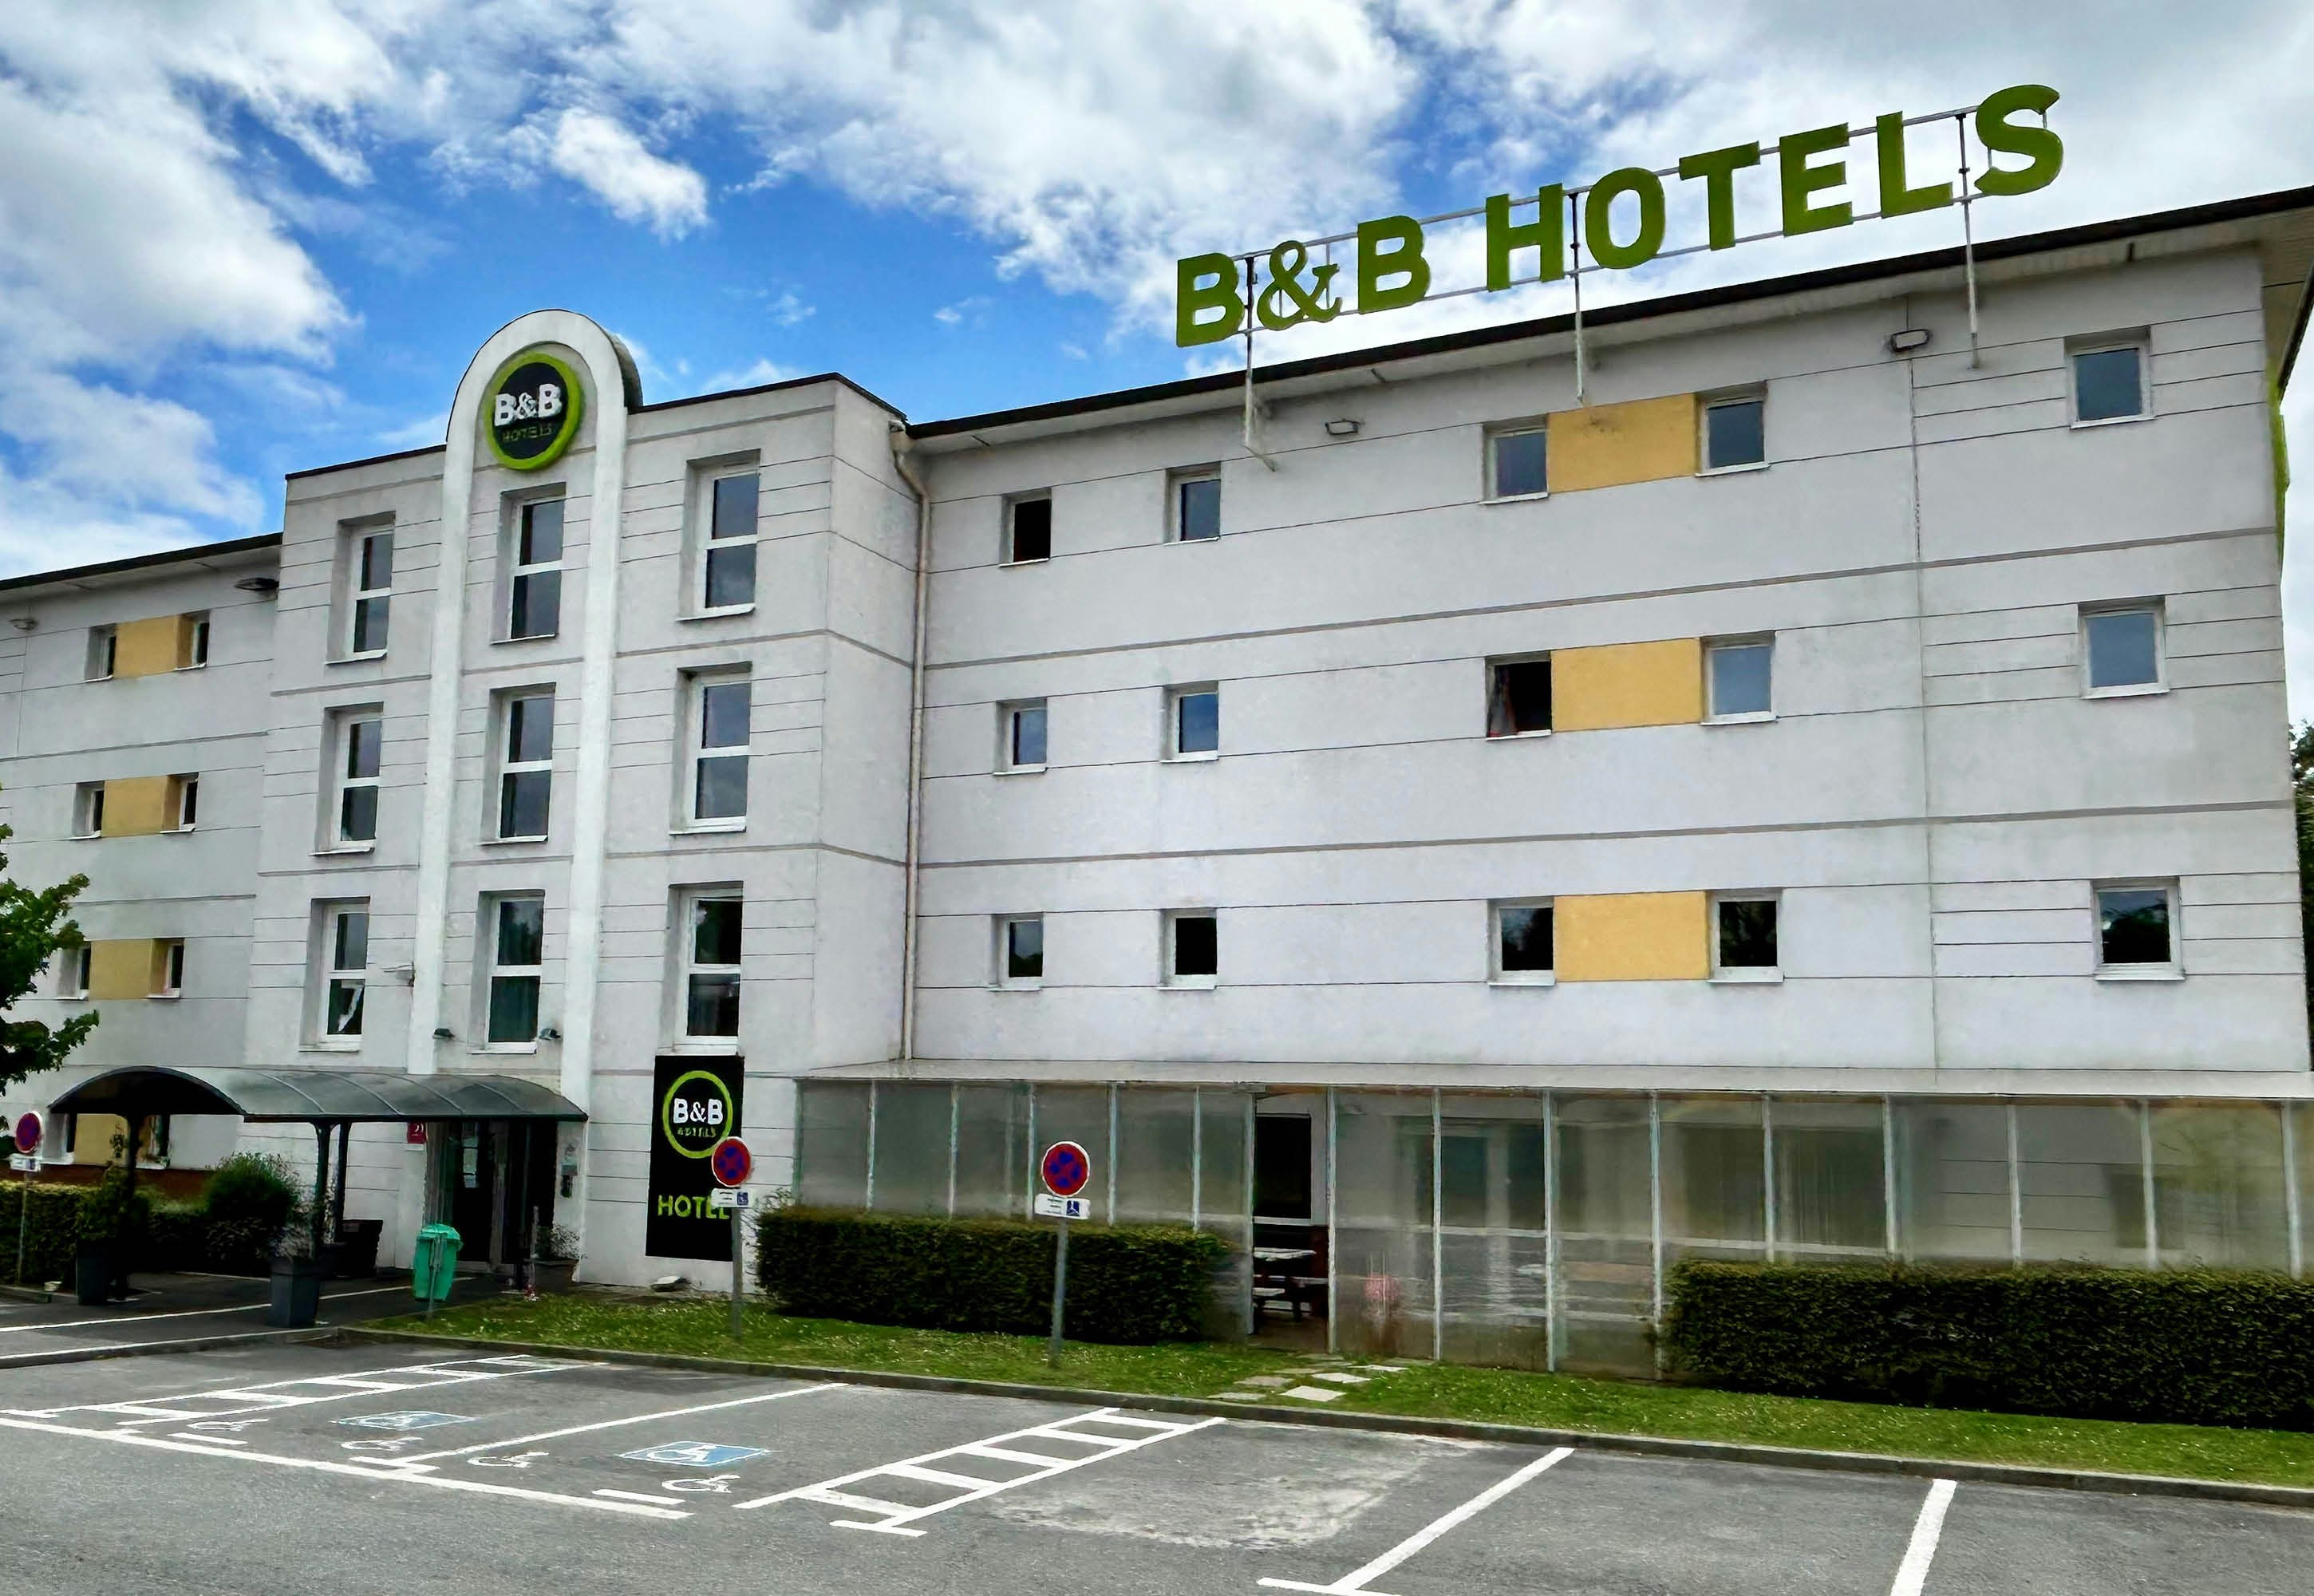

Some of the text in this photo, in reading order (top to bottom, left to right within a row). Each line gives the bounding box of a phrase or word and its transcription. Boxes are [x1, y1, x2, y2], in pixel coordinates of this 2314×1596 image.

[1176, 85, 2063, 346] B&B HOTELS
[494, 383, 562, 426] B&B
[673, 1097, 724, 1125] B&B
